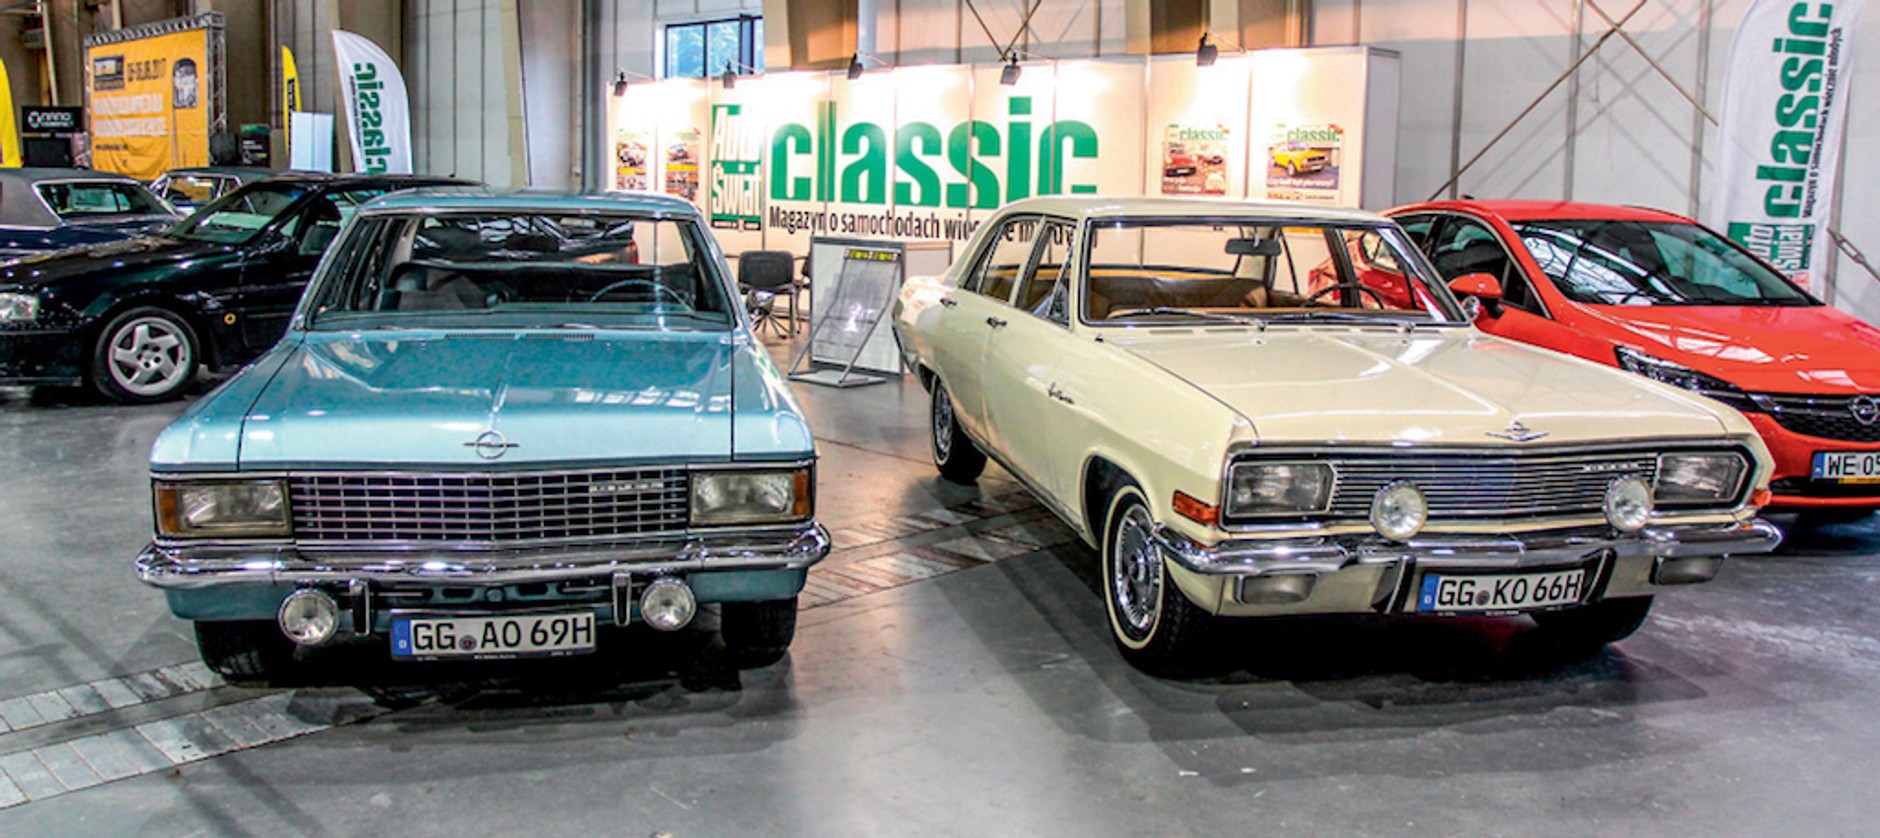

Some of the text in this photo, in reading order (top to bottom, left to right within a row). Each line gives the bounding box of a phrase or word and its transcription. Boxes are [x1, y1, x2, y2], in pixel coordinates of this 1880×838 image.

[1756, 2, 1833, 218] classic
[771, 96, 1099, 208] classic
[712, 162, 761, 215] Świat
[769, 205, 826, 235] Magazyn
[830, 212, 838, 231] o
[841, 210, 940, 239] samochodach
[1743, 224, 1775, 263] uto
[1828, 455, 1856, 476] WE
[1438, 573, 1583, 606] GG KO 66H
[413, 616, 592, 650] GG AO 69H
